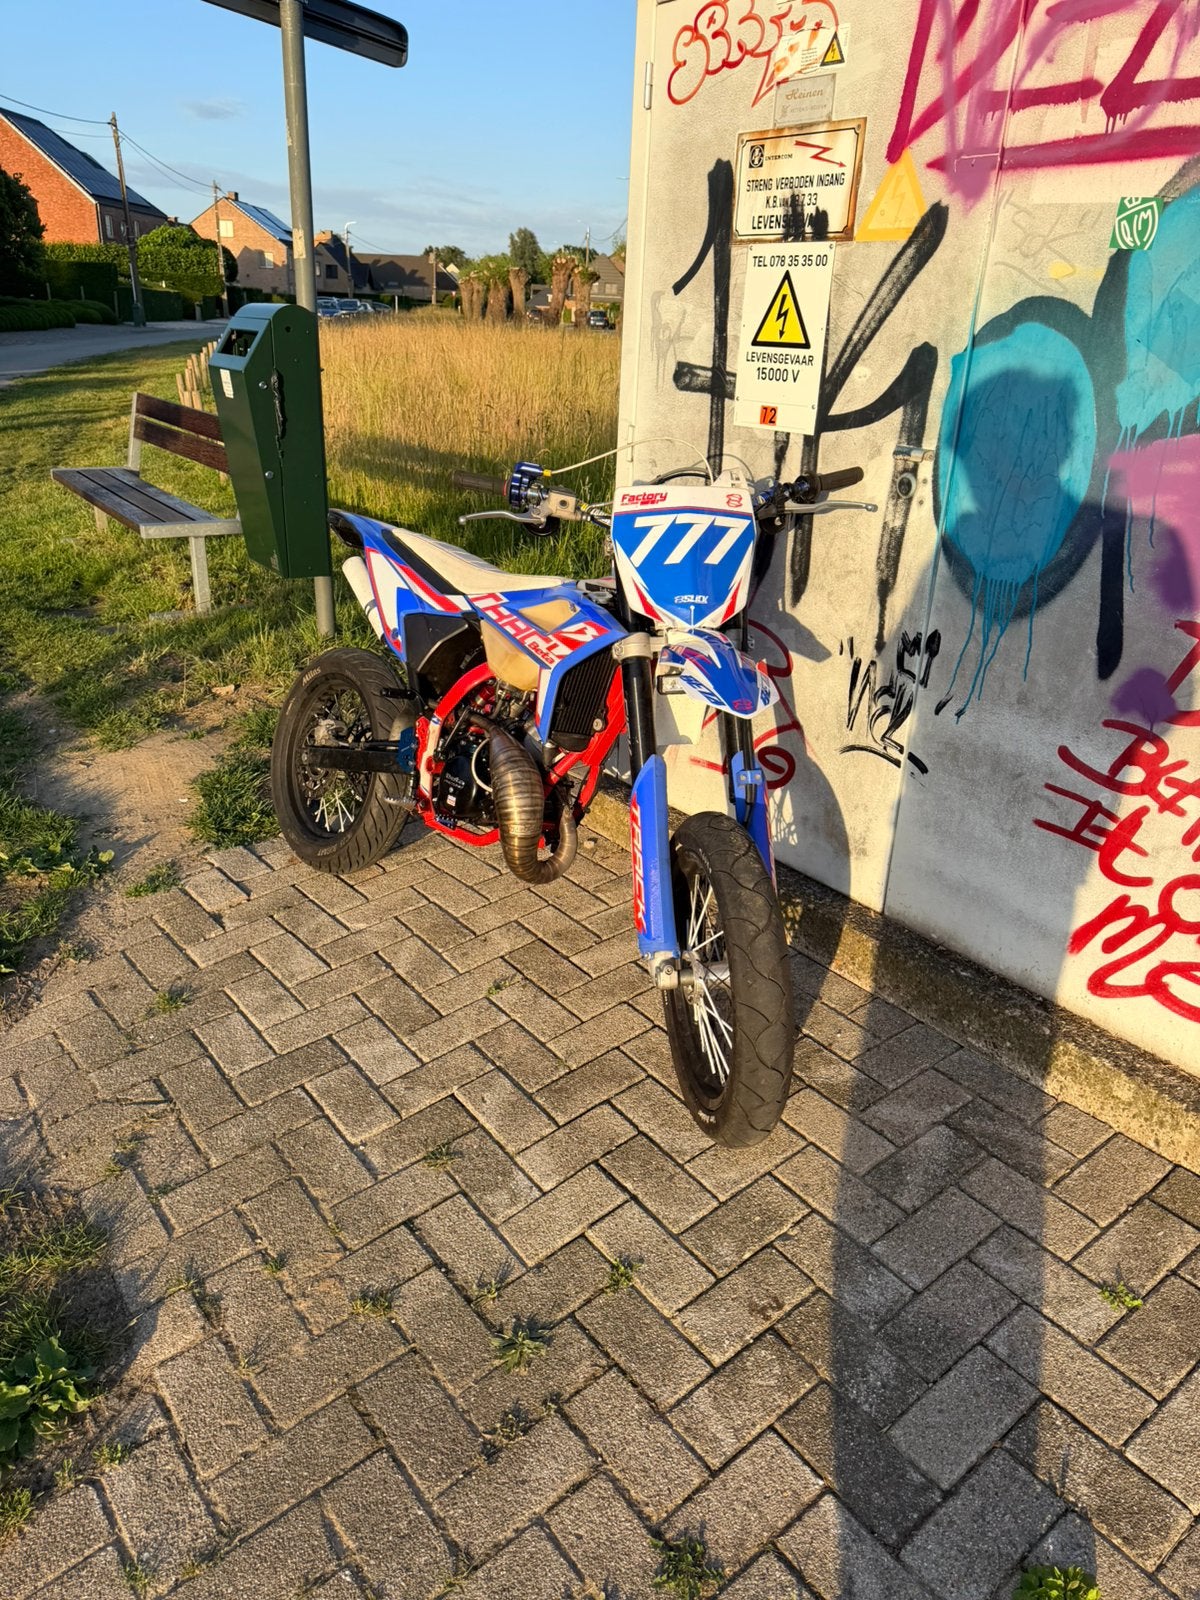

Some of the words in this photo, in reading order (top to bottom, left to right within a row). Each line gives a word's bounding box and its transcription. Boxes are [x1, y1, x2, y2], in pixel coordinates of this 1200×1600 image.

[746, 178, 773, 192] STRENG
[775, 175, 815, 190] VERBODEN
[816, 172, 845, 187] INGANG
[752, 256, 768, 268] TEL
[769, 255, 786, 268] 078
[788, 255, 800, 268] 35
[801, 254, 813, 267] 35
[815, 254, 828, 267] 00
[746, 352, 814, 366] LEVENSGEVAAR
[756, 367, 789, 382] 15000
[792, 369, 800, 383] V
[761, 406, 777, 425] 72
[620, 492, 669, 505] Factory
[630, 512, 751, 568] 777
[527, 641, 555, 665] Beta
[631, 800, 647, 934] TRACK
